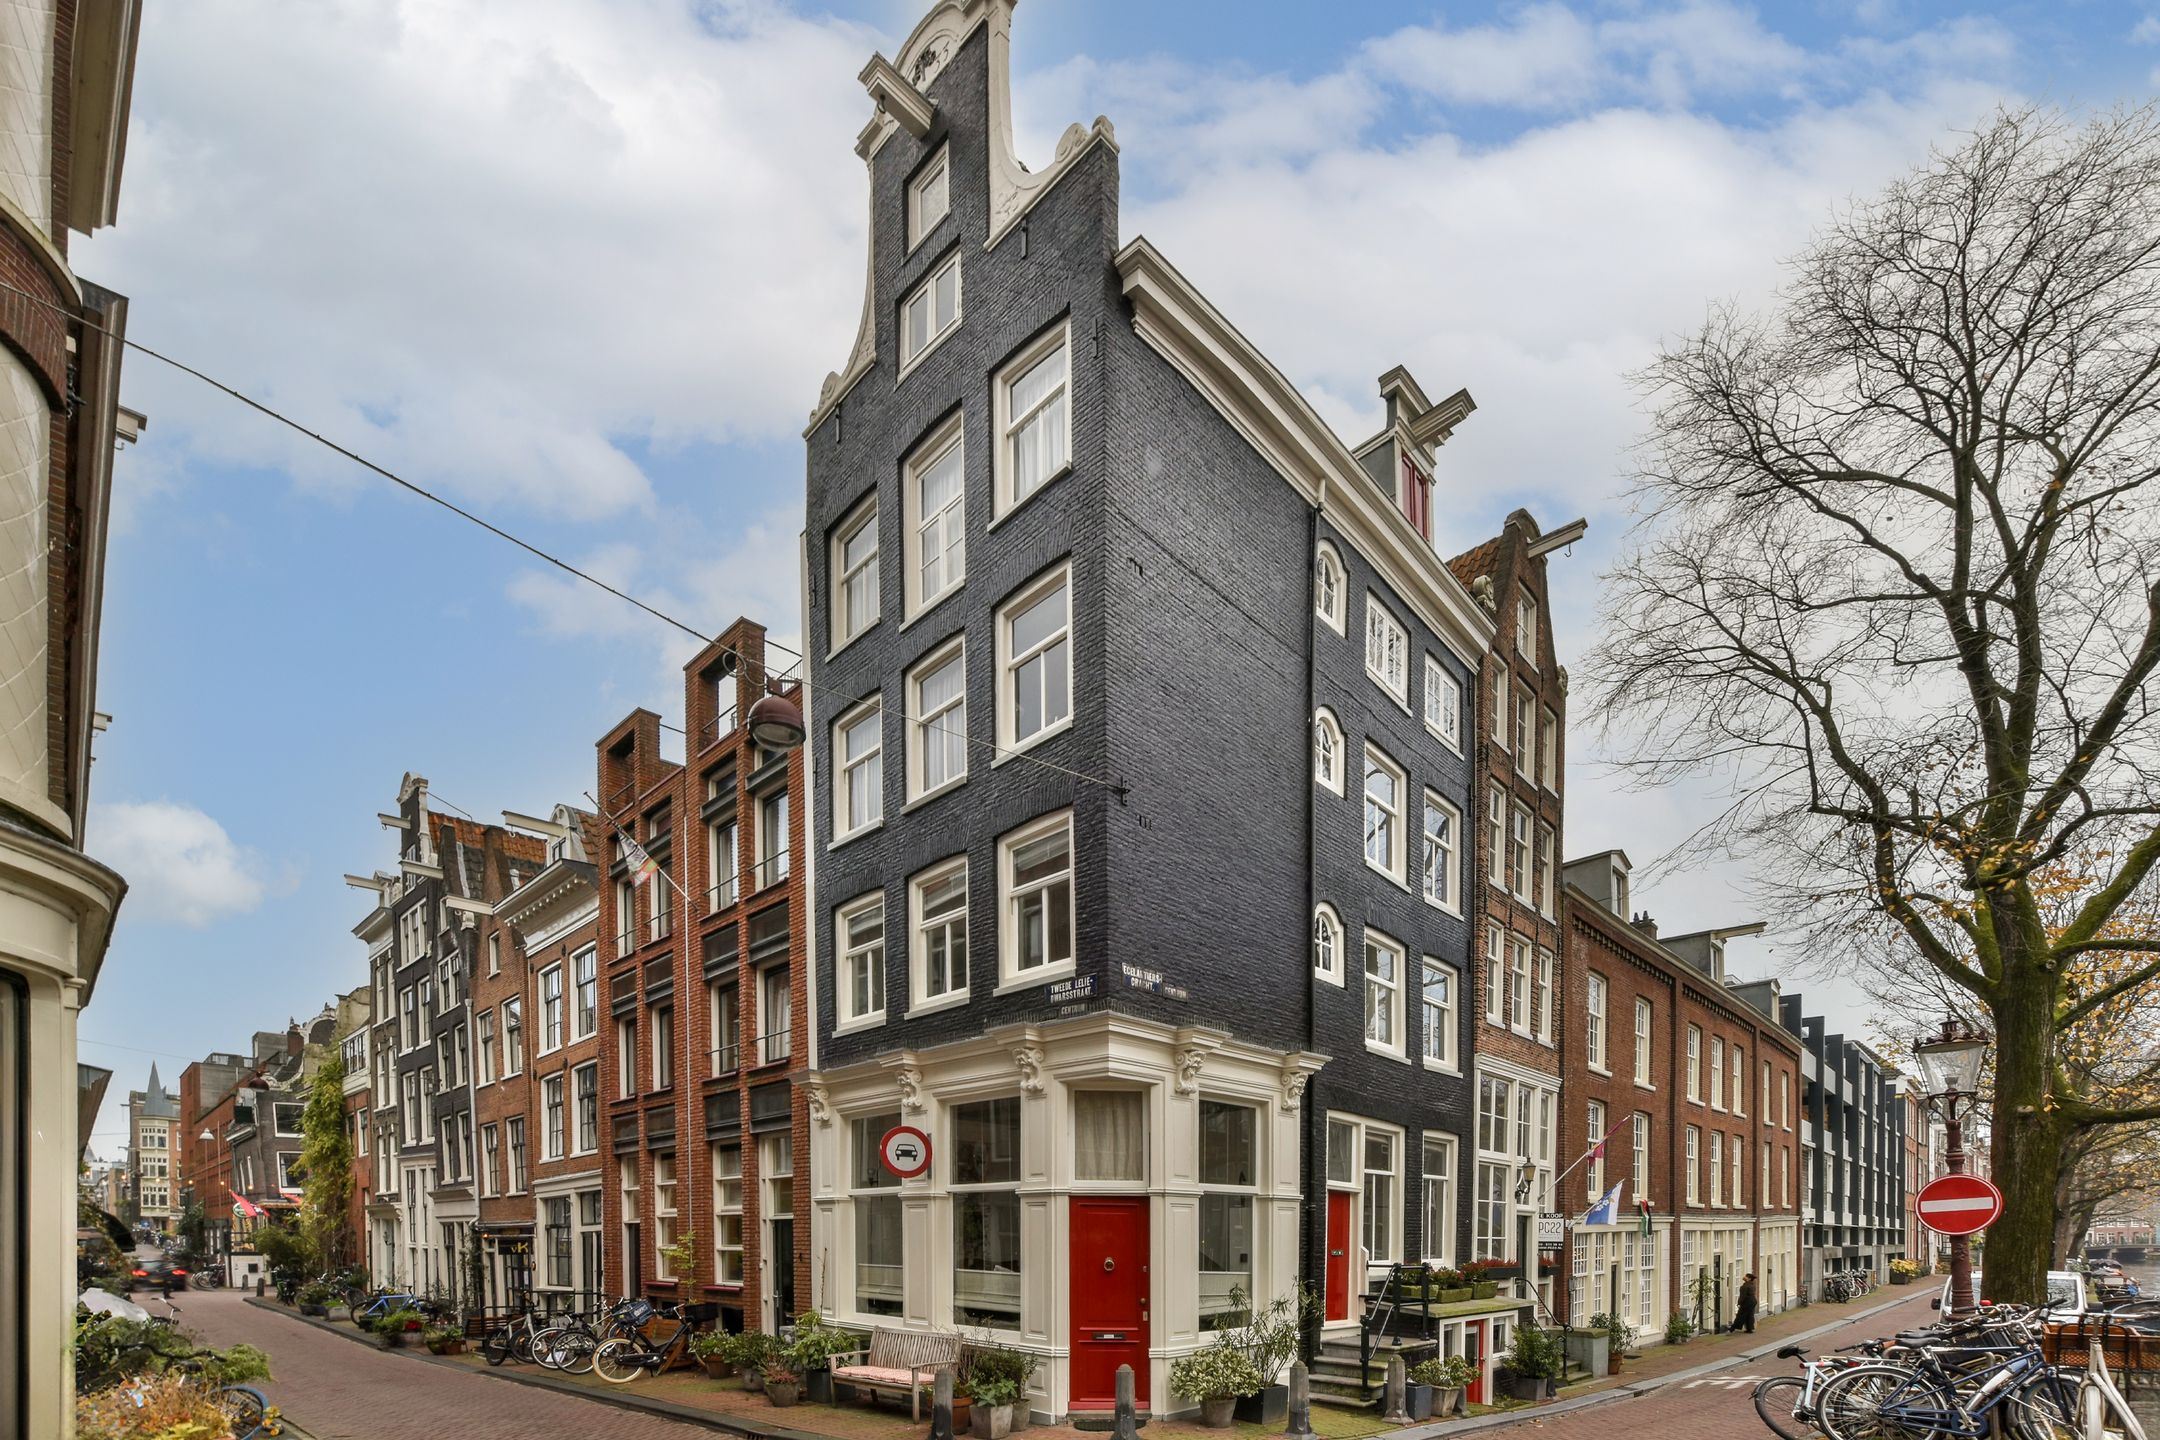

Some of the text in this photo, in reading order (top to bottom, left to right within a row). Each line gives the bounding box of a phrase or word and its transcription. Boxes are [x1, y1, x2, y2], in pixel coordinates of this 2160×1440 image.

[1050, 976, 1093, 994] TWEEDE LELIE-
[1050, 986, 1094, 1003] DWARSSTRAAT.
[1538, 1222, 1561, 1233] PC22
